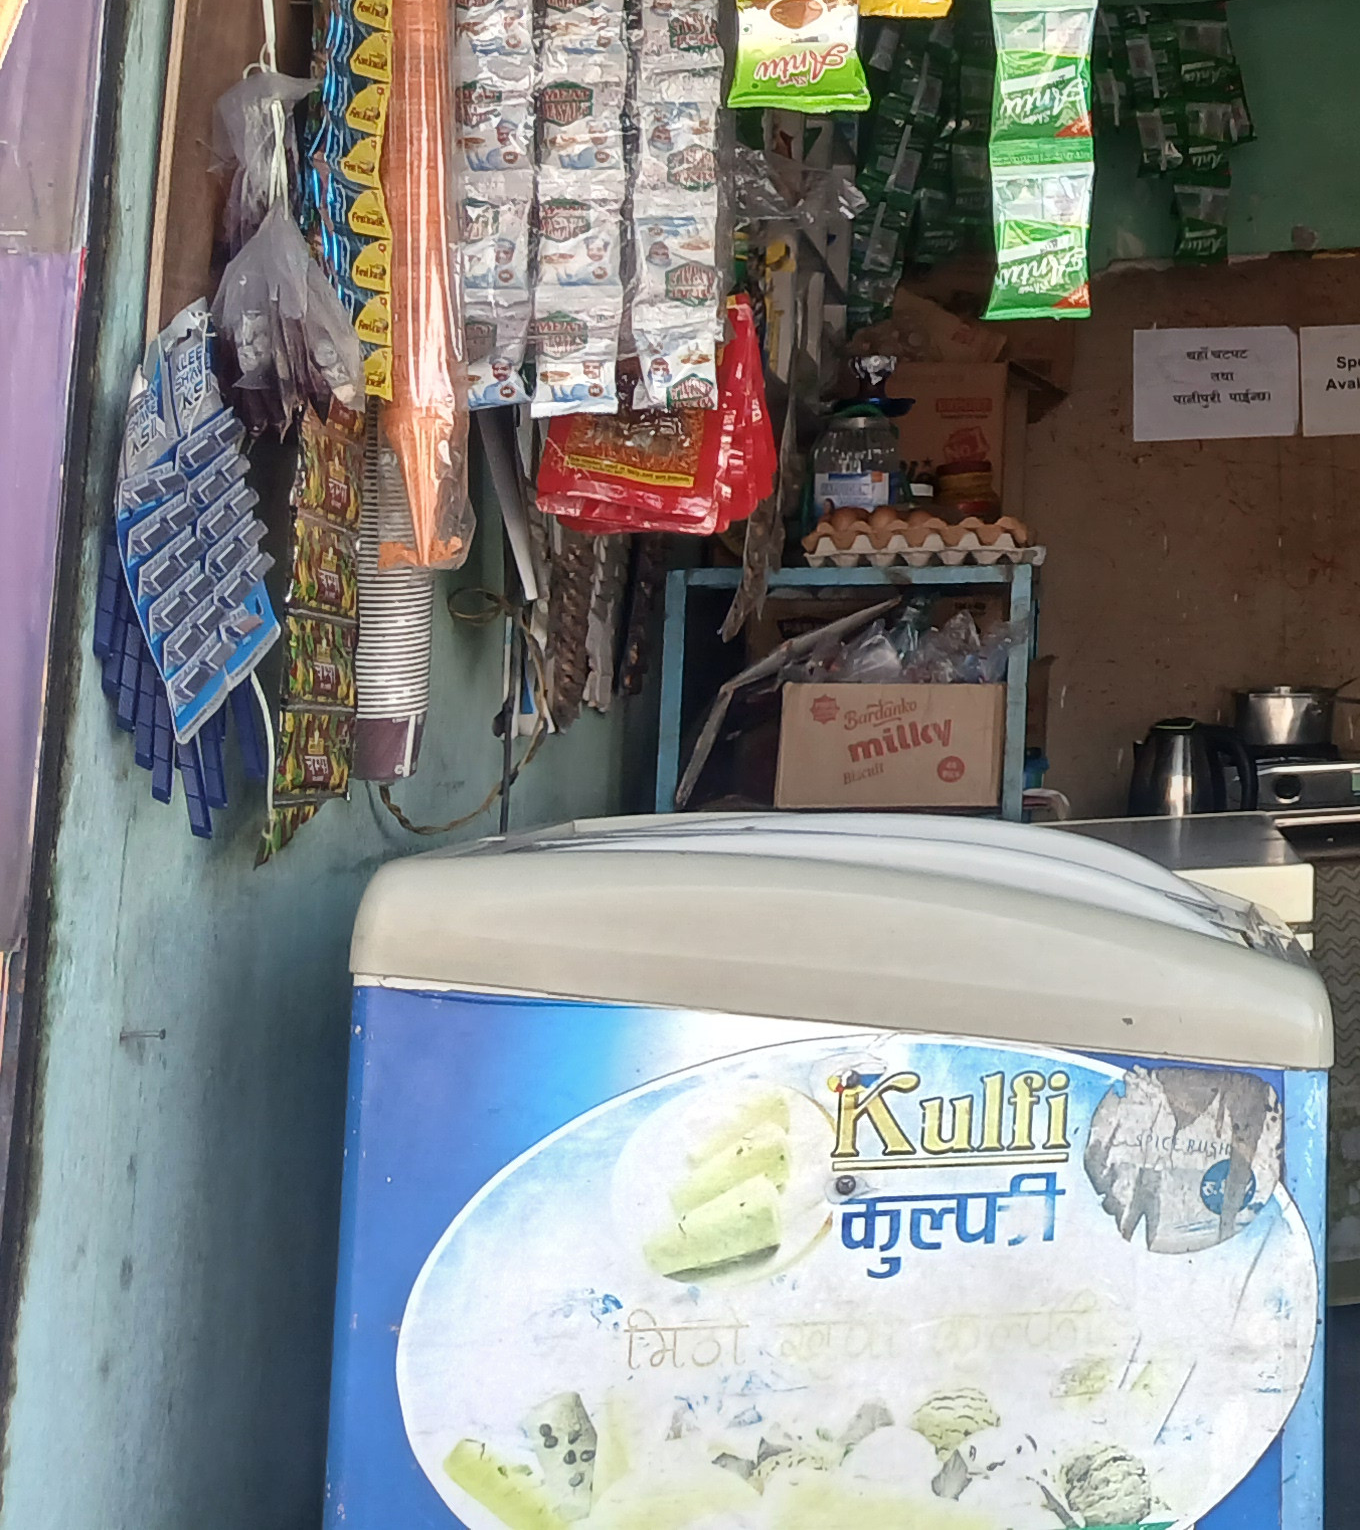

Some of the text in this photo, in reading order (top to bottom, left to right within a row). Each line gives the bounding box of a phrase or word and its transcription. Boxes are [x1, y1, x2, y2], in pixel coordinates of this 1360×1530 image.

[755, 43, 851, 82] Antu
[847, 719, 953, 763] milky
[830, 1070, 1071, 1159] Kulfi
